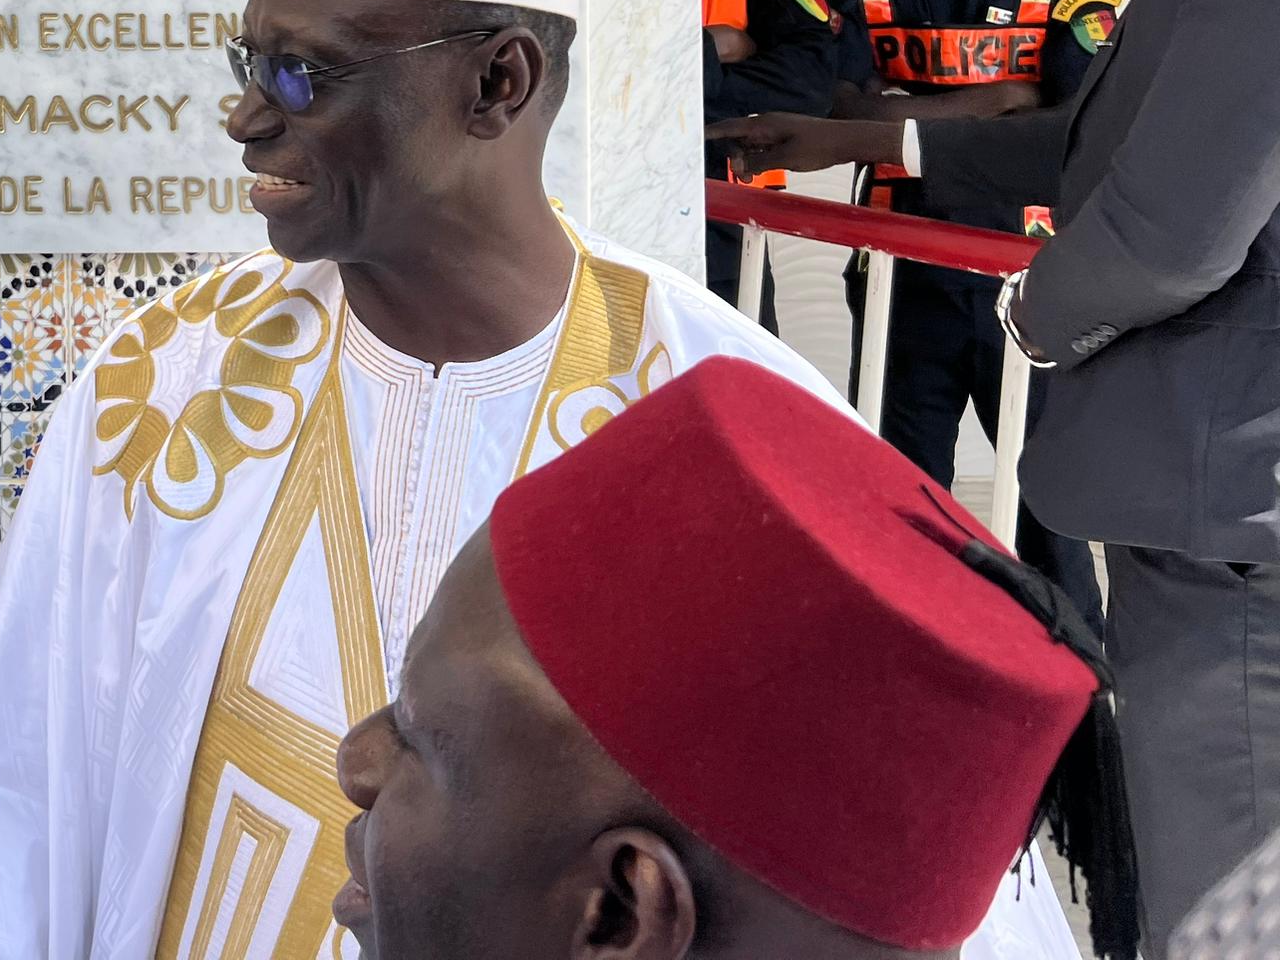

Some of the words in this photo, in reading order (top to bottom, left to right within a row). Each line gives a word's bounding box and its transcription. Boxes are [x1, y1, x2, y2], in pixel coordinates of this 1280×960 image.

[39, 12, 248, 52] EXCELLEN
[875, 34, 1038, 77] POLICE
[63, 176, 112, 215] LA
